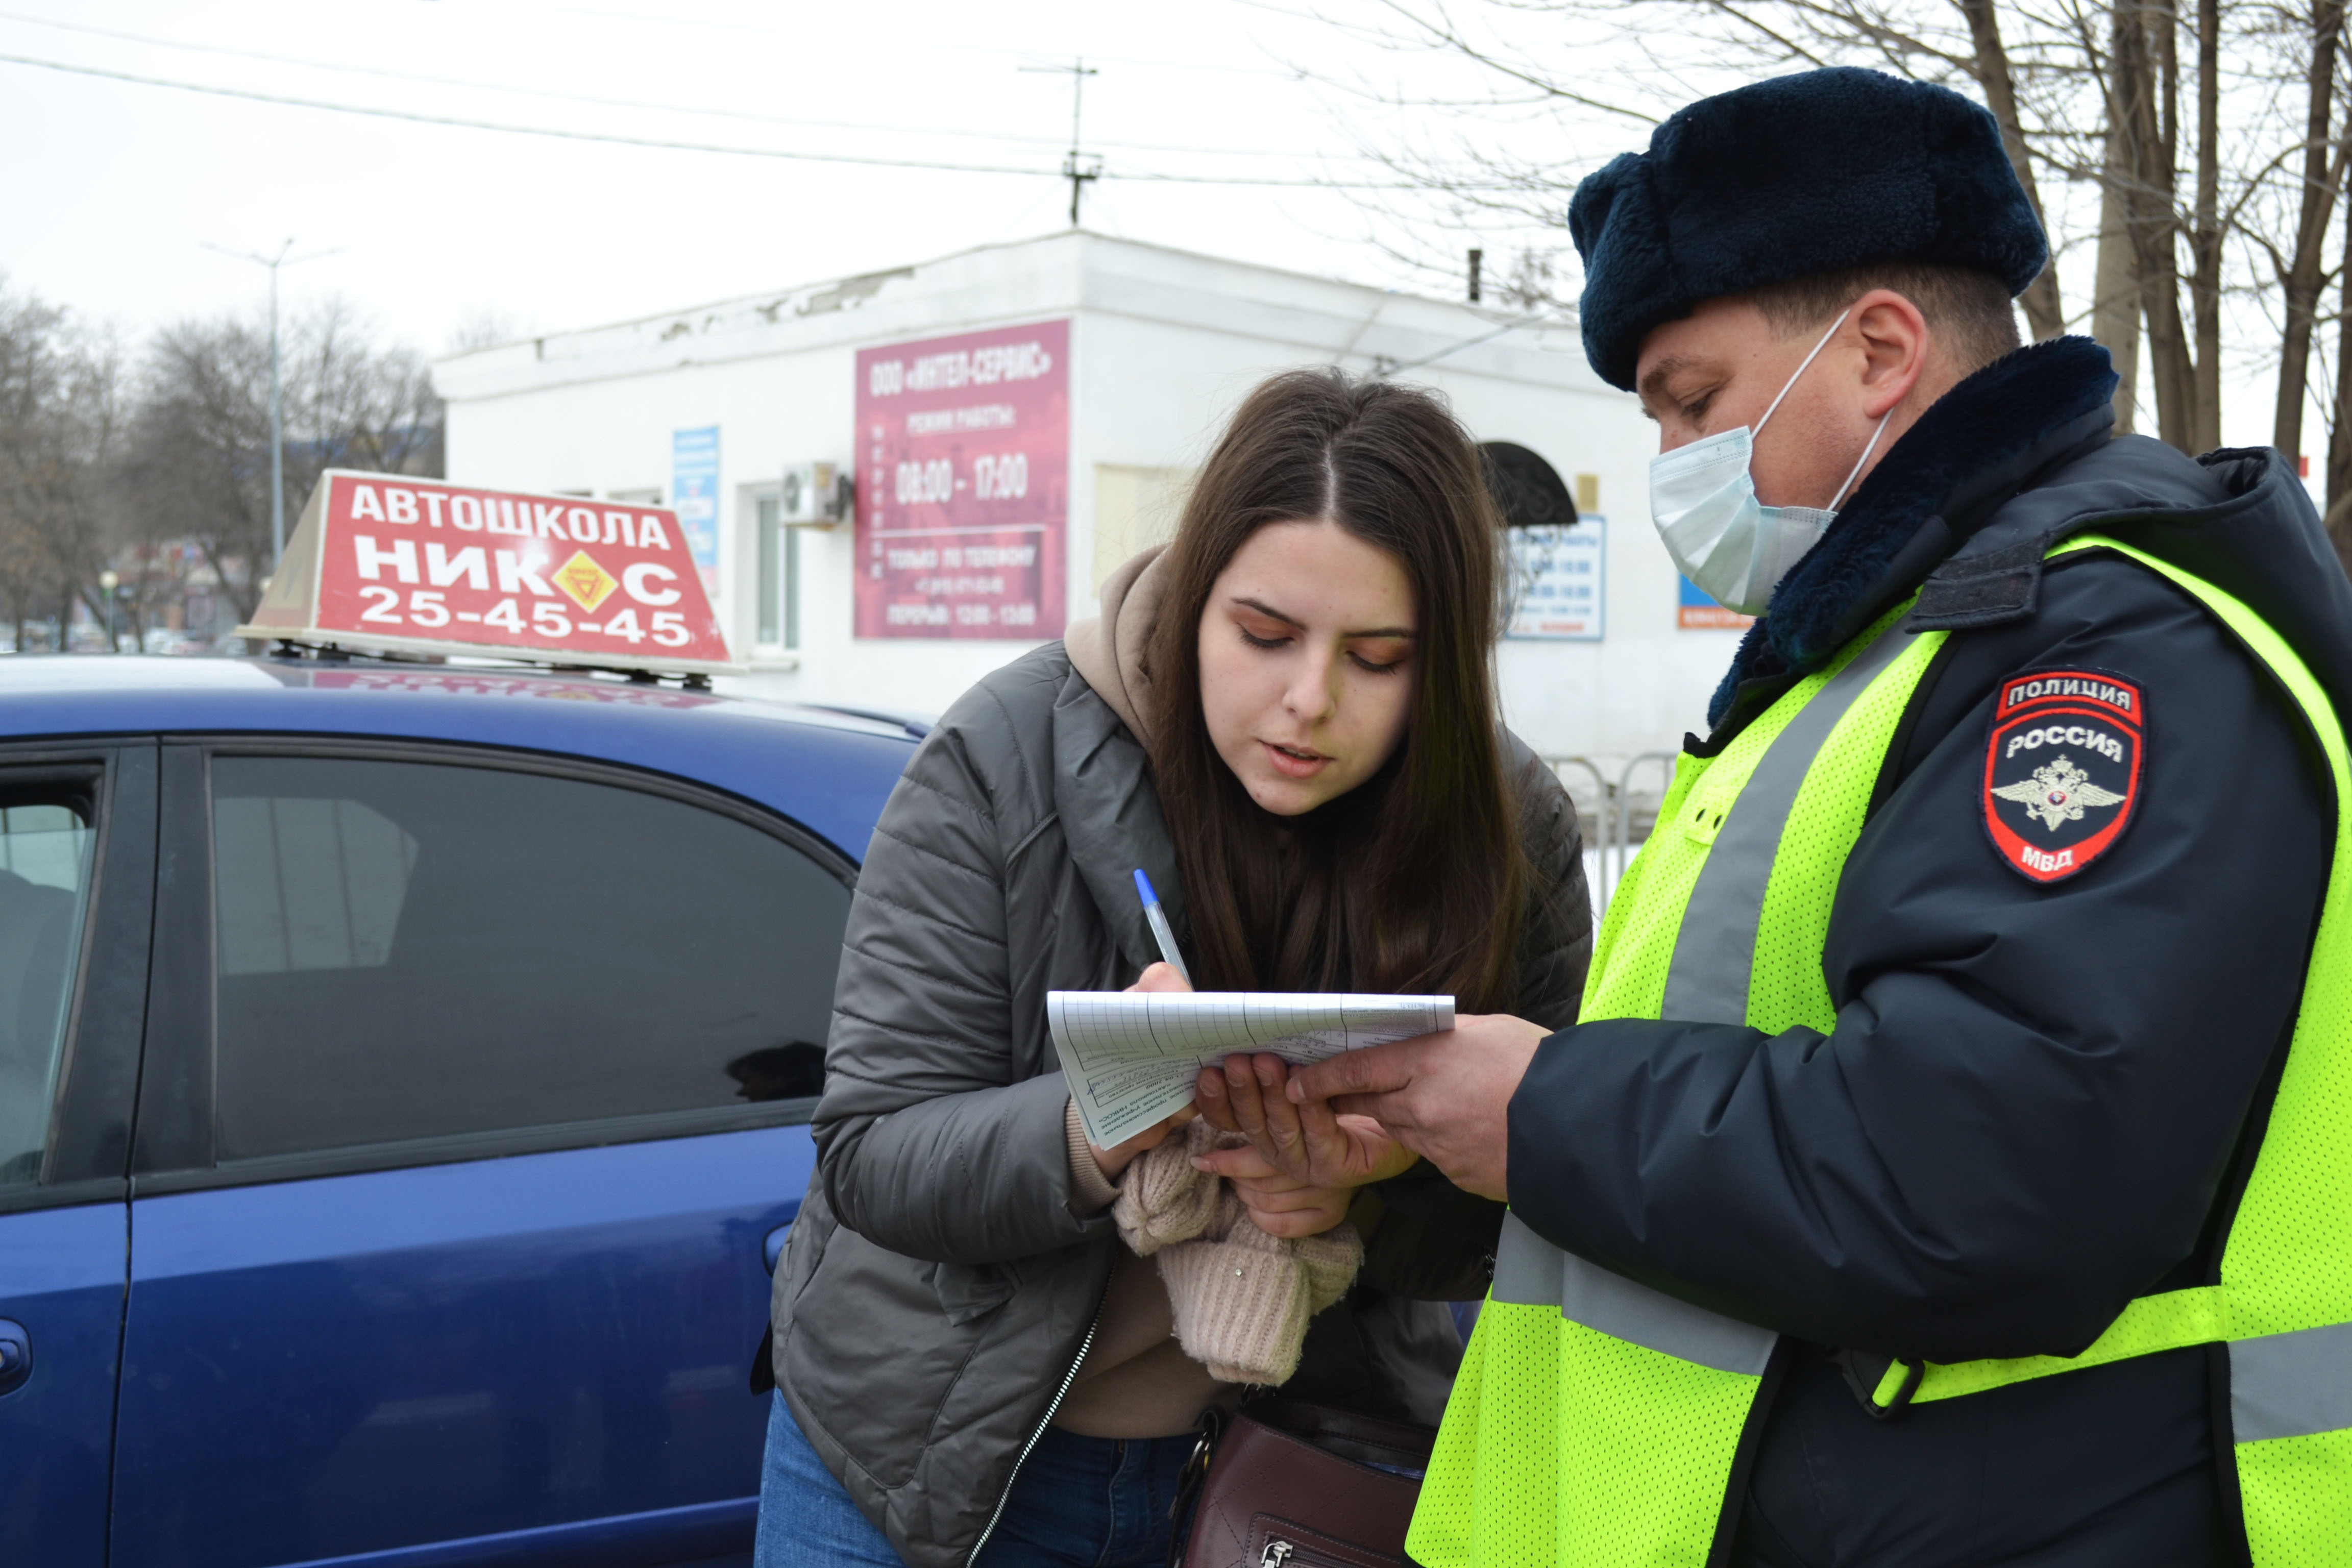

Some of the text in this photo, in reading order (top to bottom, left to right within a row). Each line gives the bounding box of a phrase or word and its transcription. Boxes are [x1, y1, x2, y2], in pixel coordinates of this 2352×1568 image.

[895, 458, 953, 505] 08:00
[974, 452, 1028, 500] 17:00
[351, 485, 671, 551] АВТОШКОЛА
[359, 586, 690, 647] 25-45-45
[2007, 679, 2132, 711] ПОЛИЦИЯ
[2005, 726, 2124, 763] РОССИЯ
[2021, 846, 2074, 872] МВД
[1101, 1104, 1141, 1130] учреждение
[1104, 1099, 1168, 1136] профессиональное
